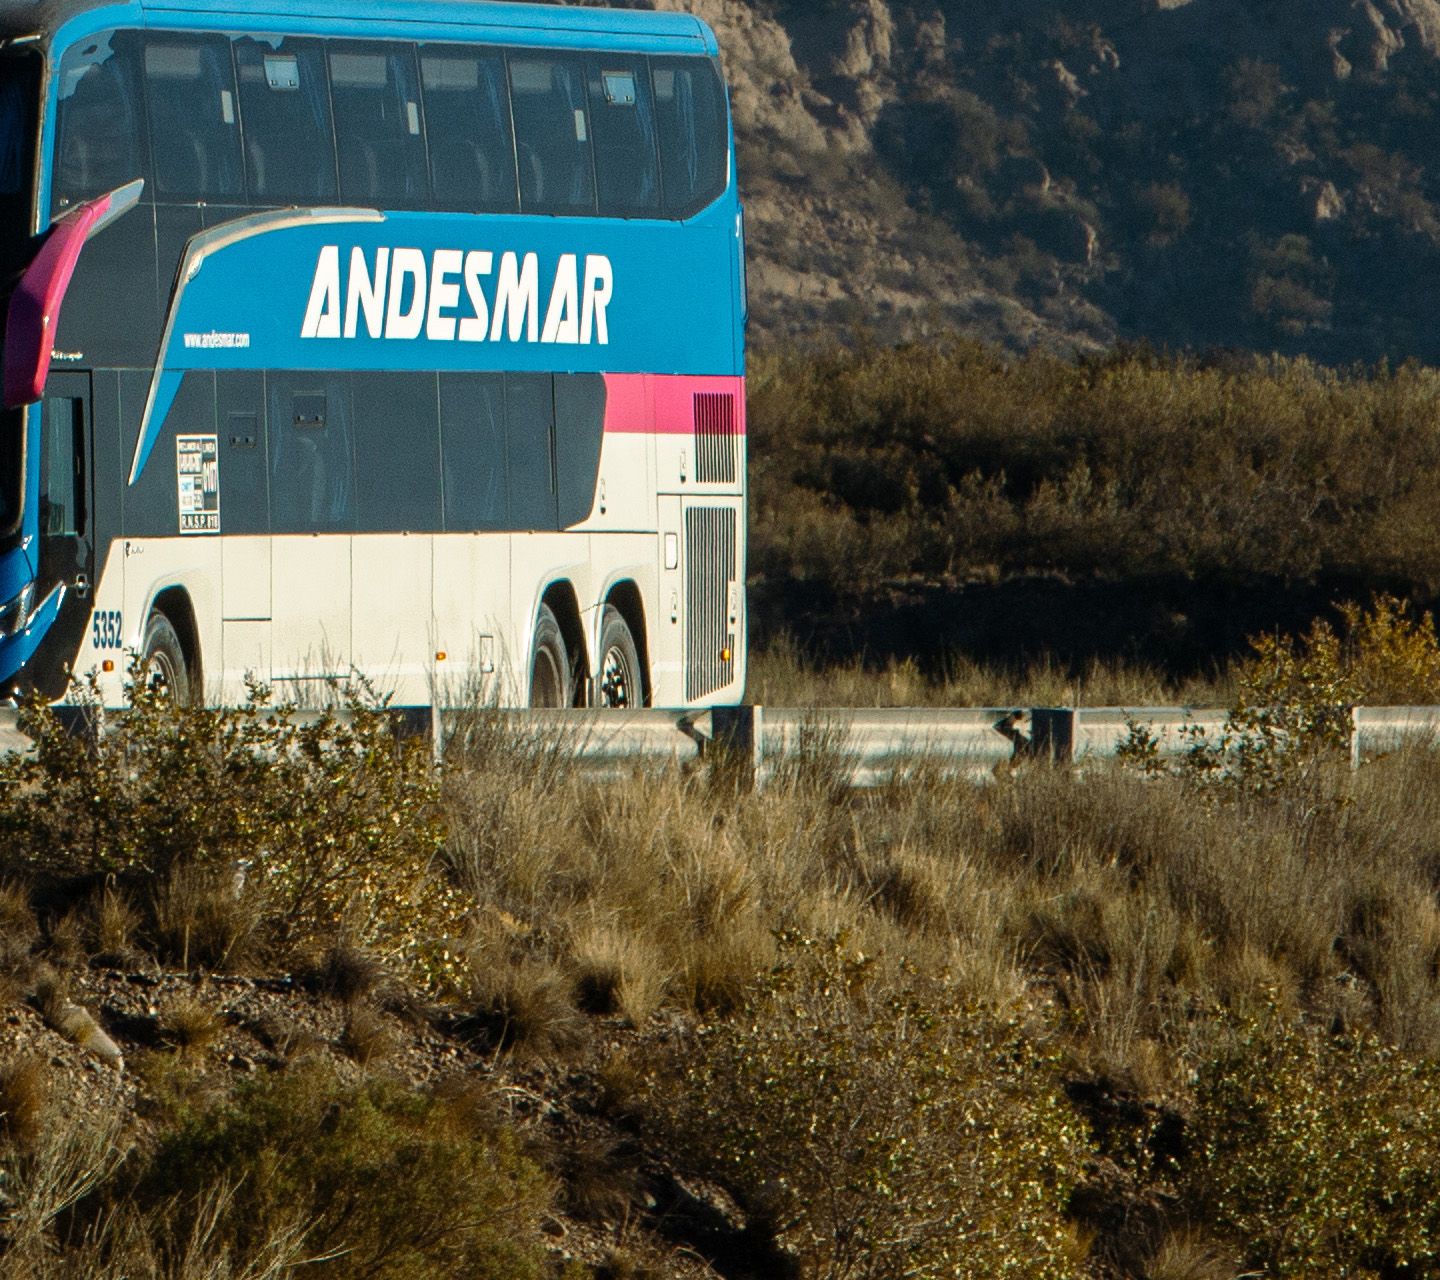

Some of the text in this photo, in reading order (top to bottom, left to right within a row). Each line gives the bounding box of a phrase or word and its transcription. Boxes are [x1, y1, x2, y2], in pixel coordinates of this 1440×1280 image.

[301, 246, 613, 345] ANDESMAR
[183, 330, 250, 348] www.andesmar.com
[93, 610, 122, 649] 5352
